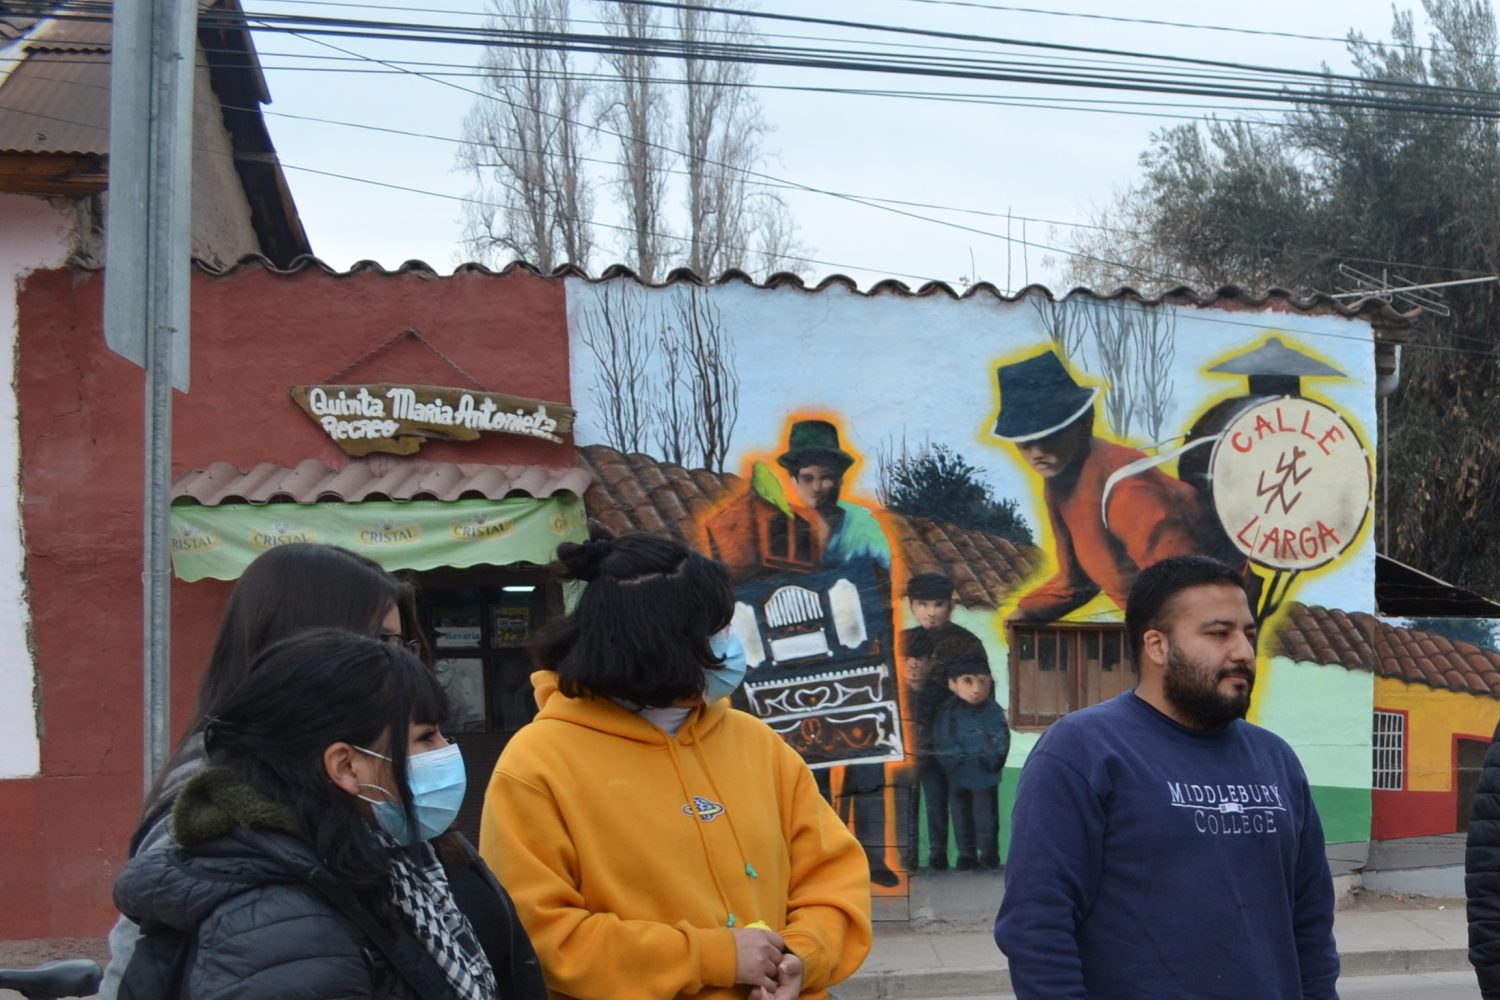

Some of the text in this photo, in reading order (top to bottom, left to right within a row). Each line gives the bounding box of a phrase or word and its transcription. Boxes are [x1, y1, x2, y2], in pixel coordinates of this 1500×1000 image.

[310, 388, 558, 434] Quinta Maria Antonieta
[321, 416, 399, 439] Recreo
[1231, 407, 1345, 456] CALLE
[360, 527, 418, 543] CRISTAL
[454, 522, 510, 538] CRISTAL
[1236, 515, 1341, 560] LARGA
[171, 536, 214, 549] RISTAL
[1167, 781, 1283, 806] MIDDLEBURY
[1195, 810, 1277, 834] COLLEGE
